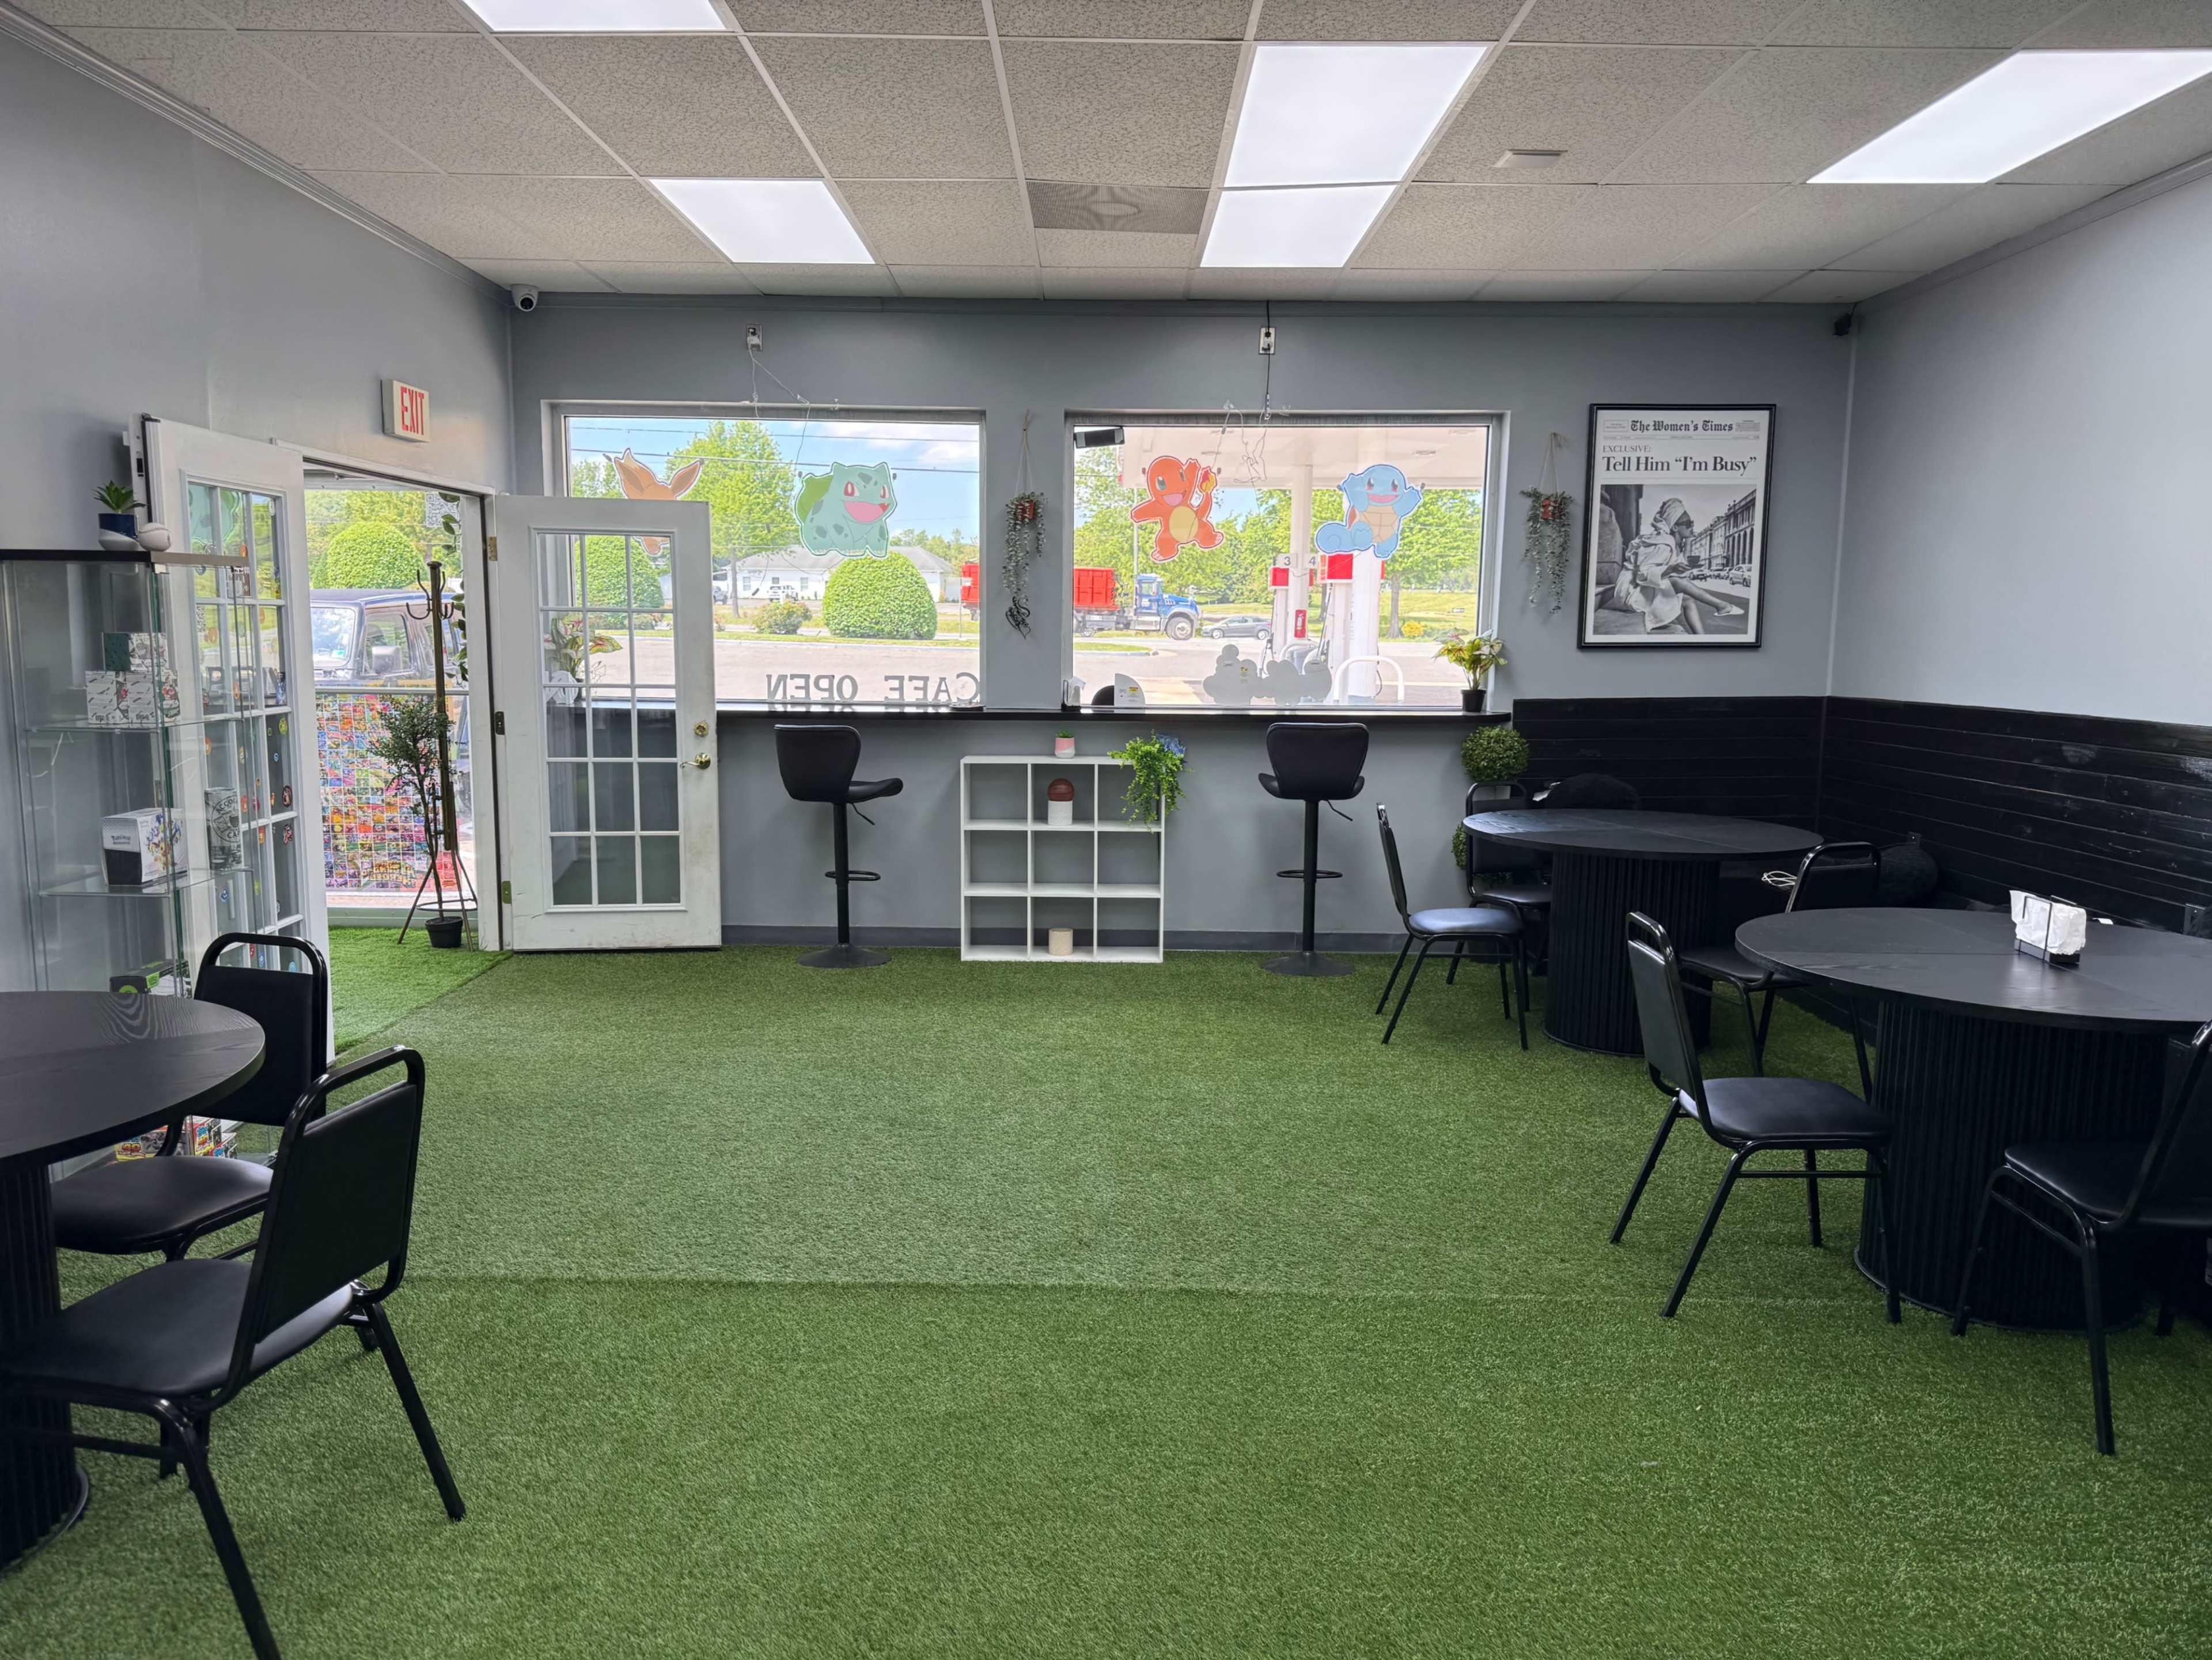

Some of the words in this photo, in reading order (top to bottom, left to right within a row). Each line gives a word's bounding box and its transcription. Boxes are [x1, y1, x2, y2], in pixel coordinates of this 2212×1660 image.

[400, 386, 425, 436] EXIT
[1631, 419, 1650, 433] The
[1653, 420, 1698, 432] Women's
[1702, 419, 1733, 432] Times
[1602, 456, 1631, 471] Tell
[1635, 456, 1671, 471] Him
[1284, 556, 1291, 566] 3
[1309, 557, 1316, 566] 4
